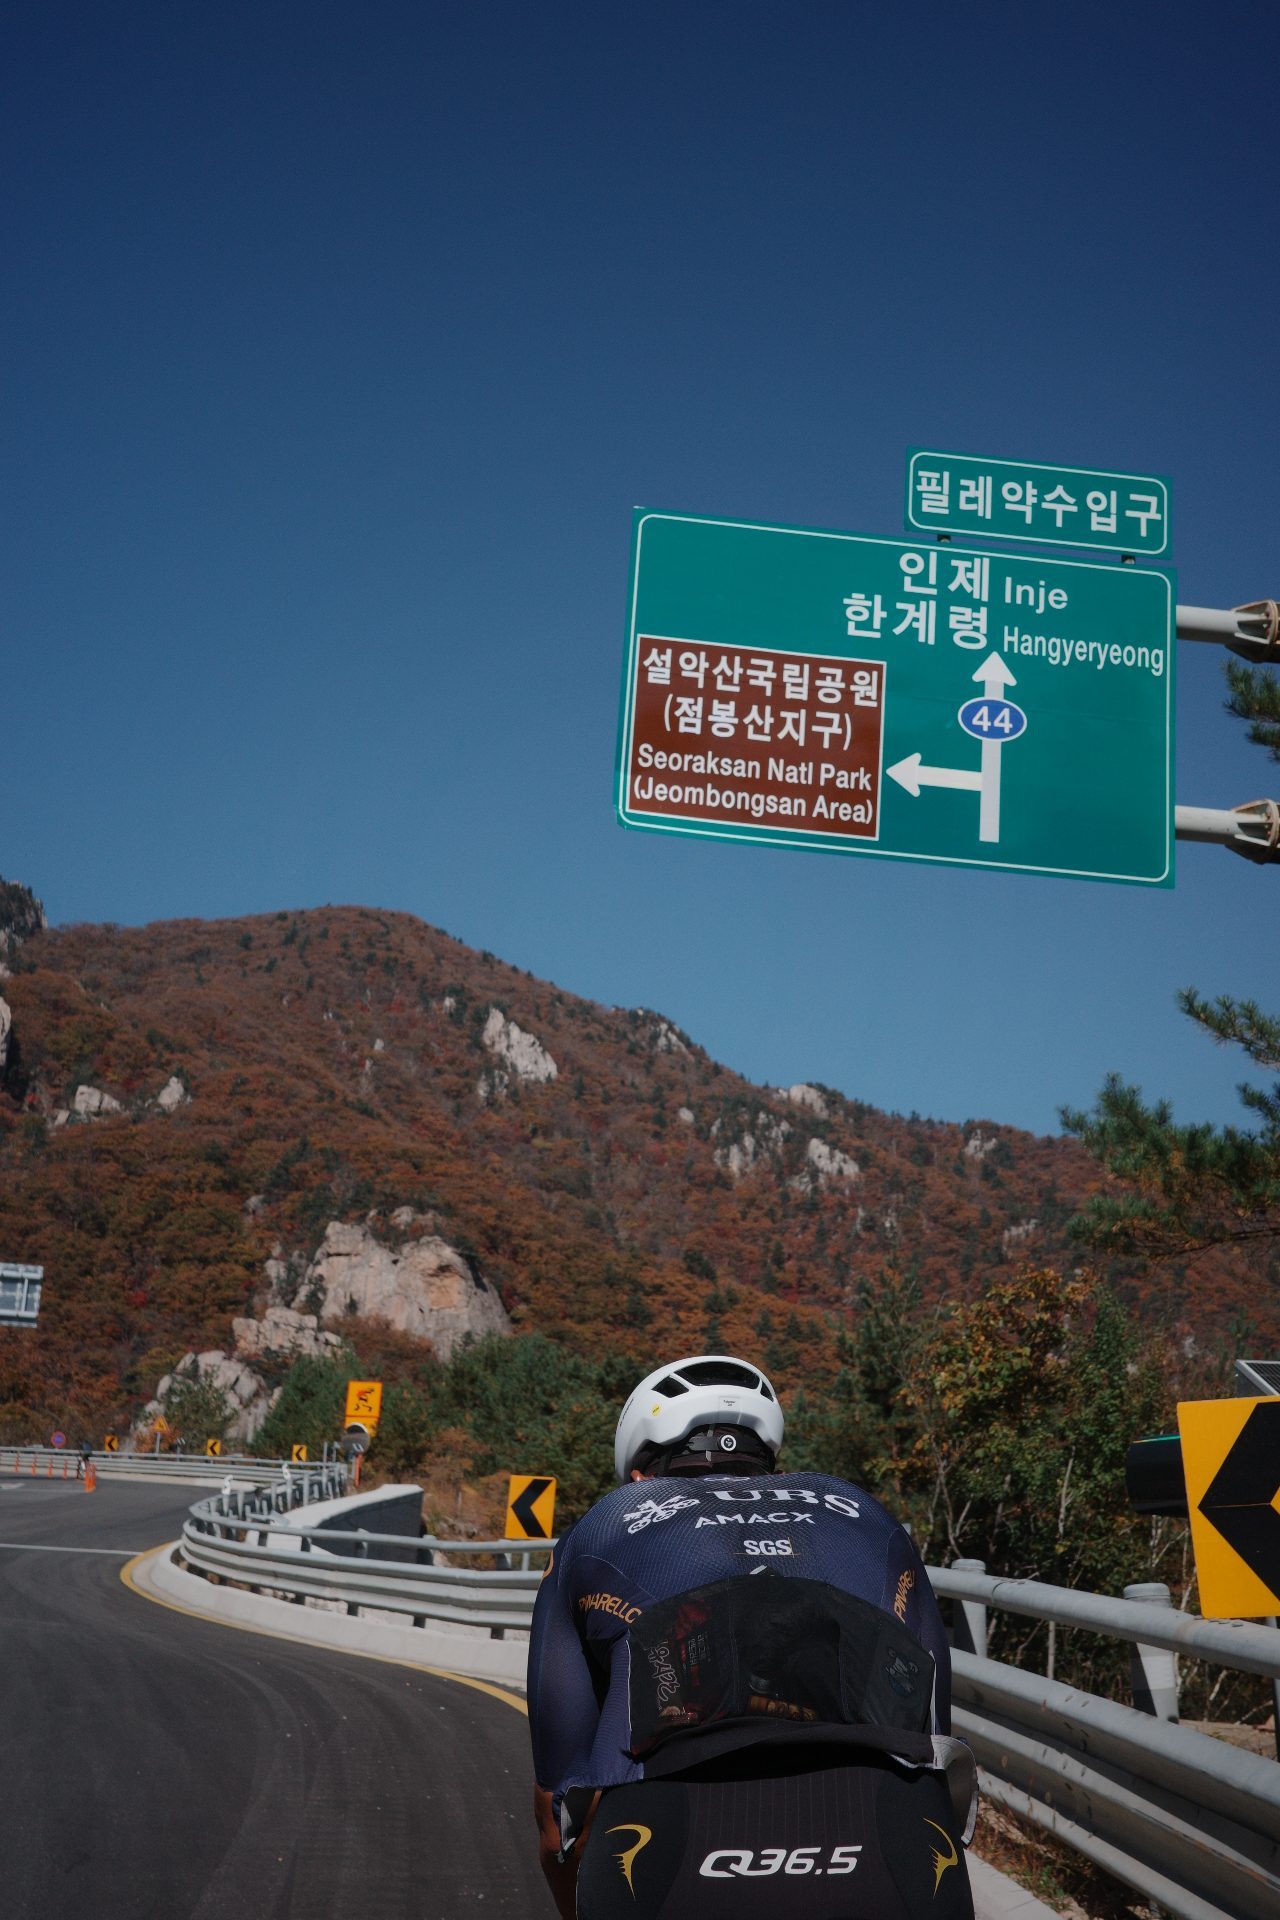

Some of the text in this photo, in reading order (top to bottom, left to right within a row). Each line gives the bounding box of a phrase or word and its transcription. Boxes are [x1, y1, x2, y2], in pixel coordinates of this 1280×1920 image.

[916, 470, 1162, 537] 필레약수입구
[899, 551, 990, 602] 인제
[1003, 576, 1069, 614] Inje
[843, 592, 989, 651] 한계령
[1003, 625, 1164, 676] Hangyeryeong
[643, 648, 879, 708] 설악산국립공원
[664, 693, 852, 751] (점봉산지구)
[971, 705, 1013, 734] 44
[638, 743, 872, 791] Seoraksan Natl Park
[633, 774, 873, 825] (Jeombongsan Area)
[695, 1512, 815, 1529] AMACX
[707, 1489, 861, 1518] UBS
[743, 1539, 793, 1556] SGS
[699, 1845, 863, 1877] Q36.5
